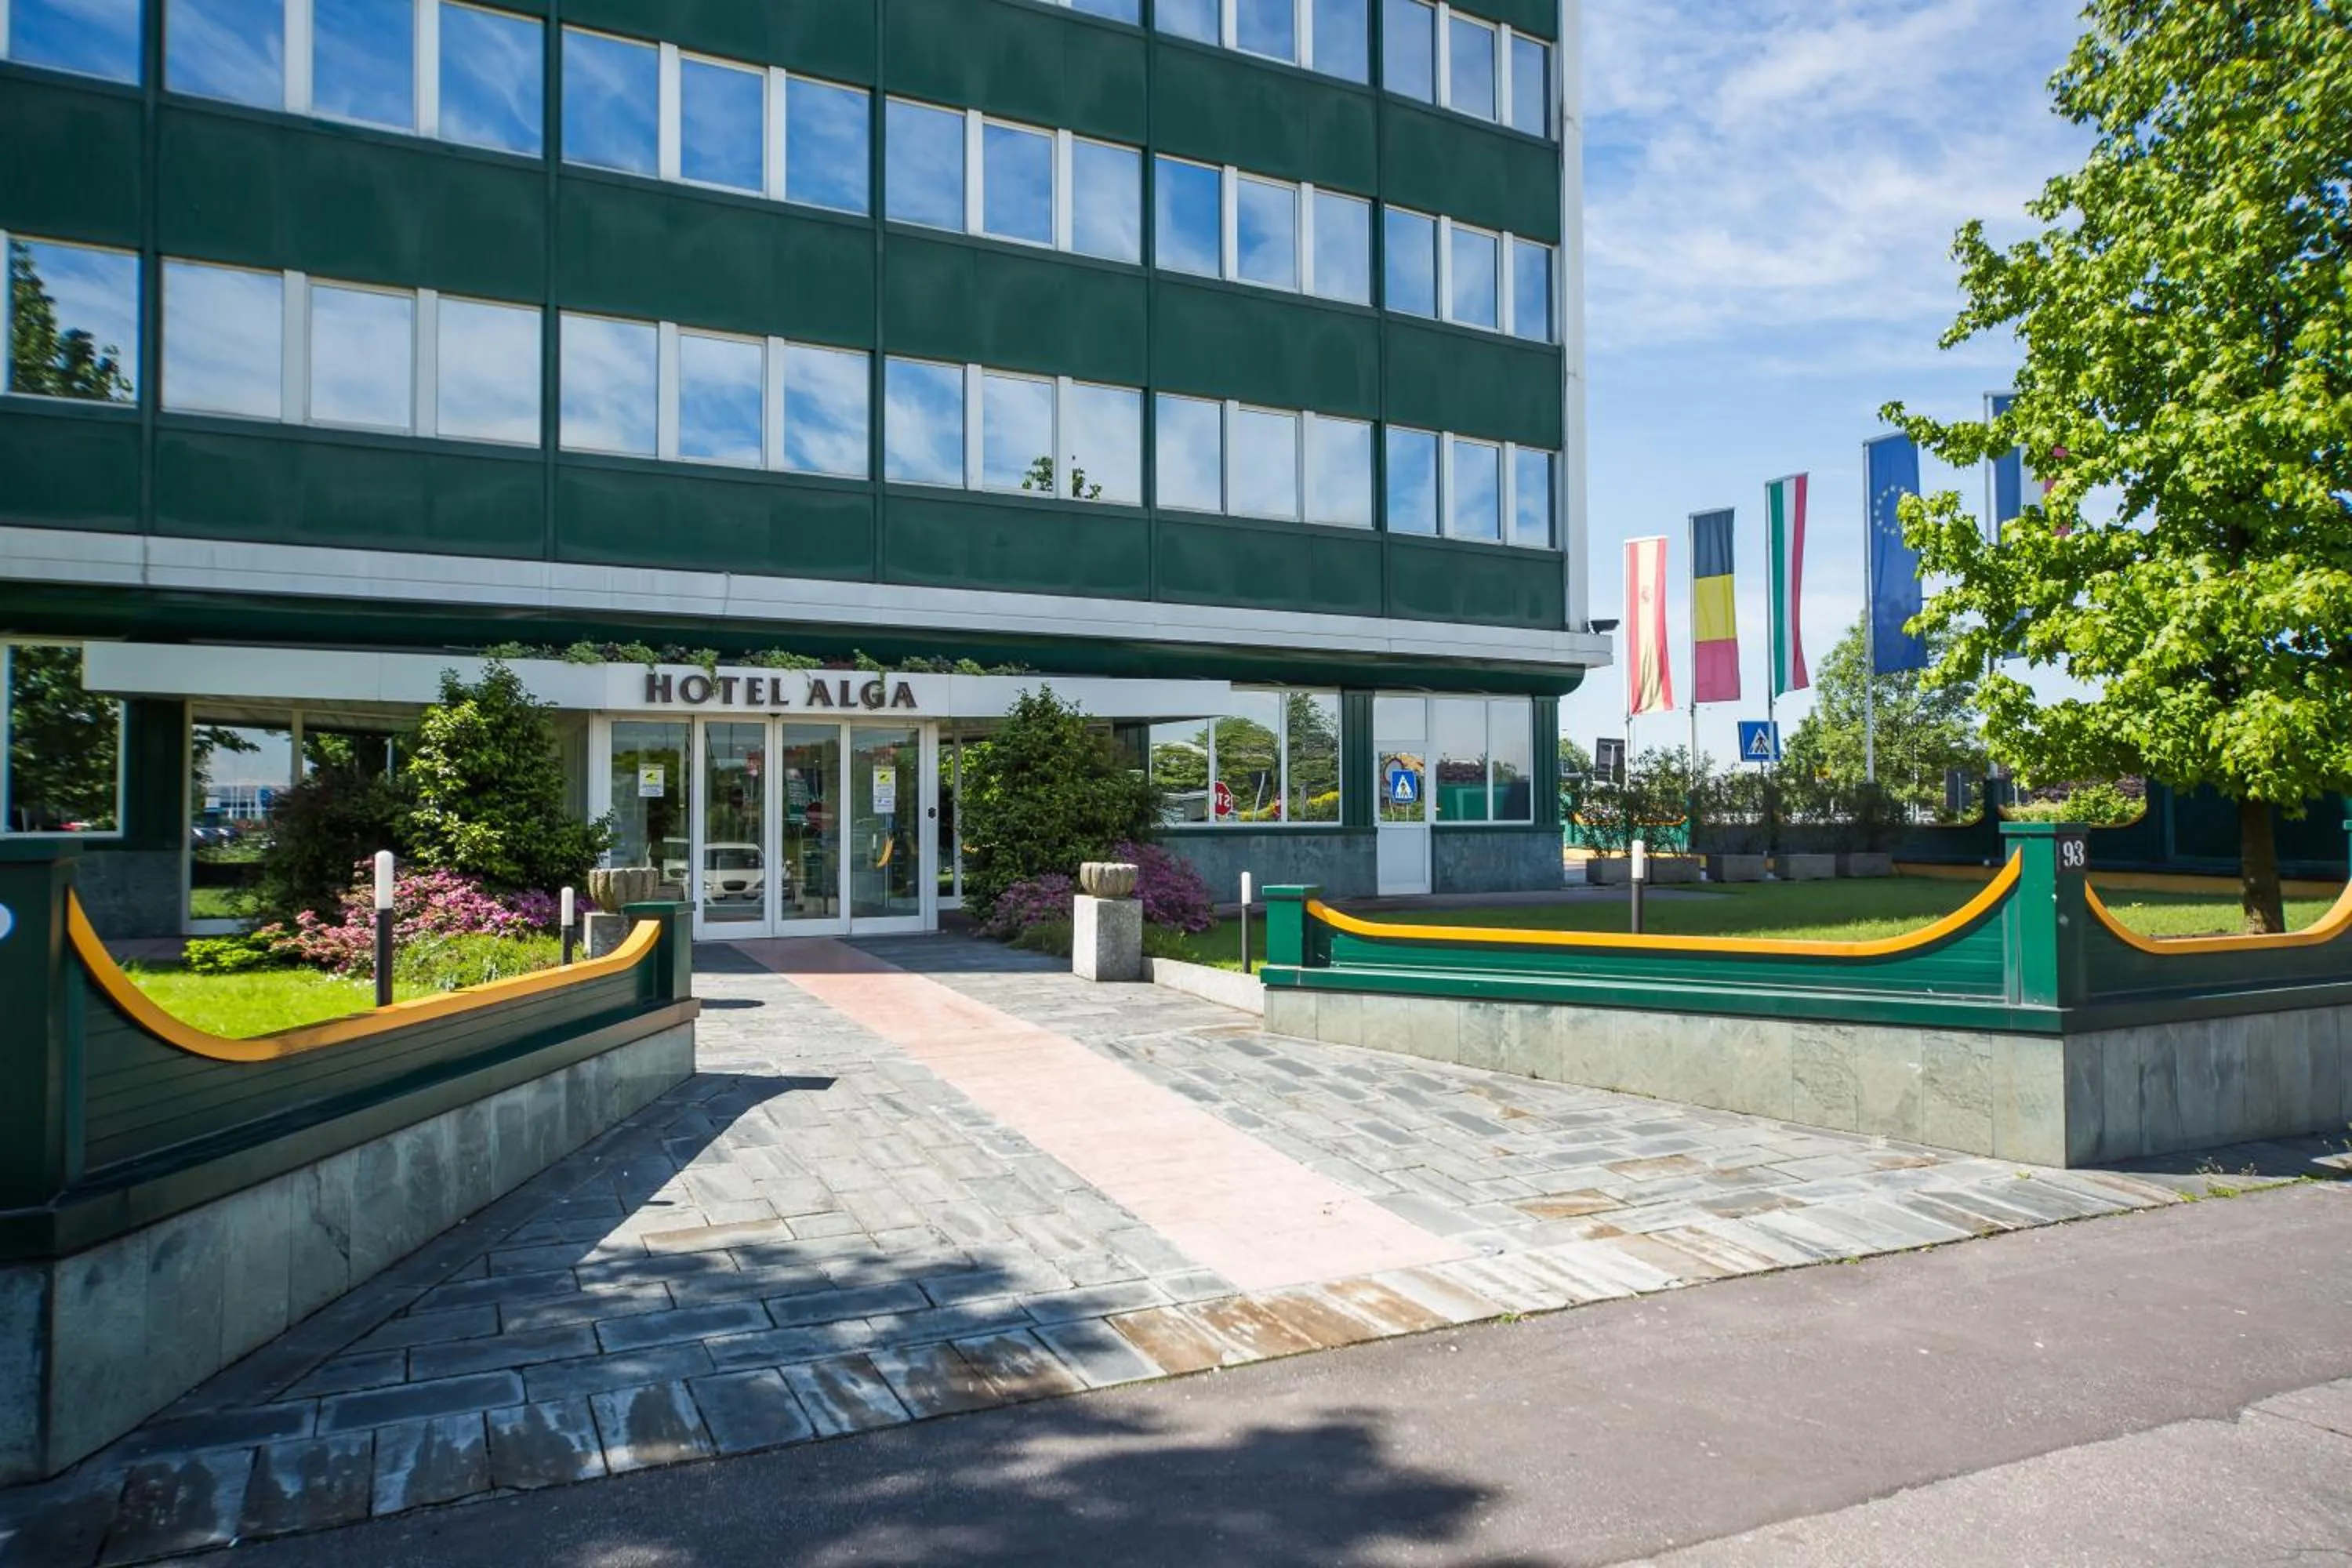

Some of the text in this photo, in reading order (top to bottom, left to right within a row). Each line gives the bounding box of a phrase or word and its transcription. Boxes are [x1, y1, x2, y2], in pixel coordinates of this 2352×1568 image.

[646, 674, 917, 708] HOTEL ALGA
[2063, 840, 2085, 867] 93
